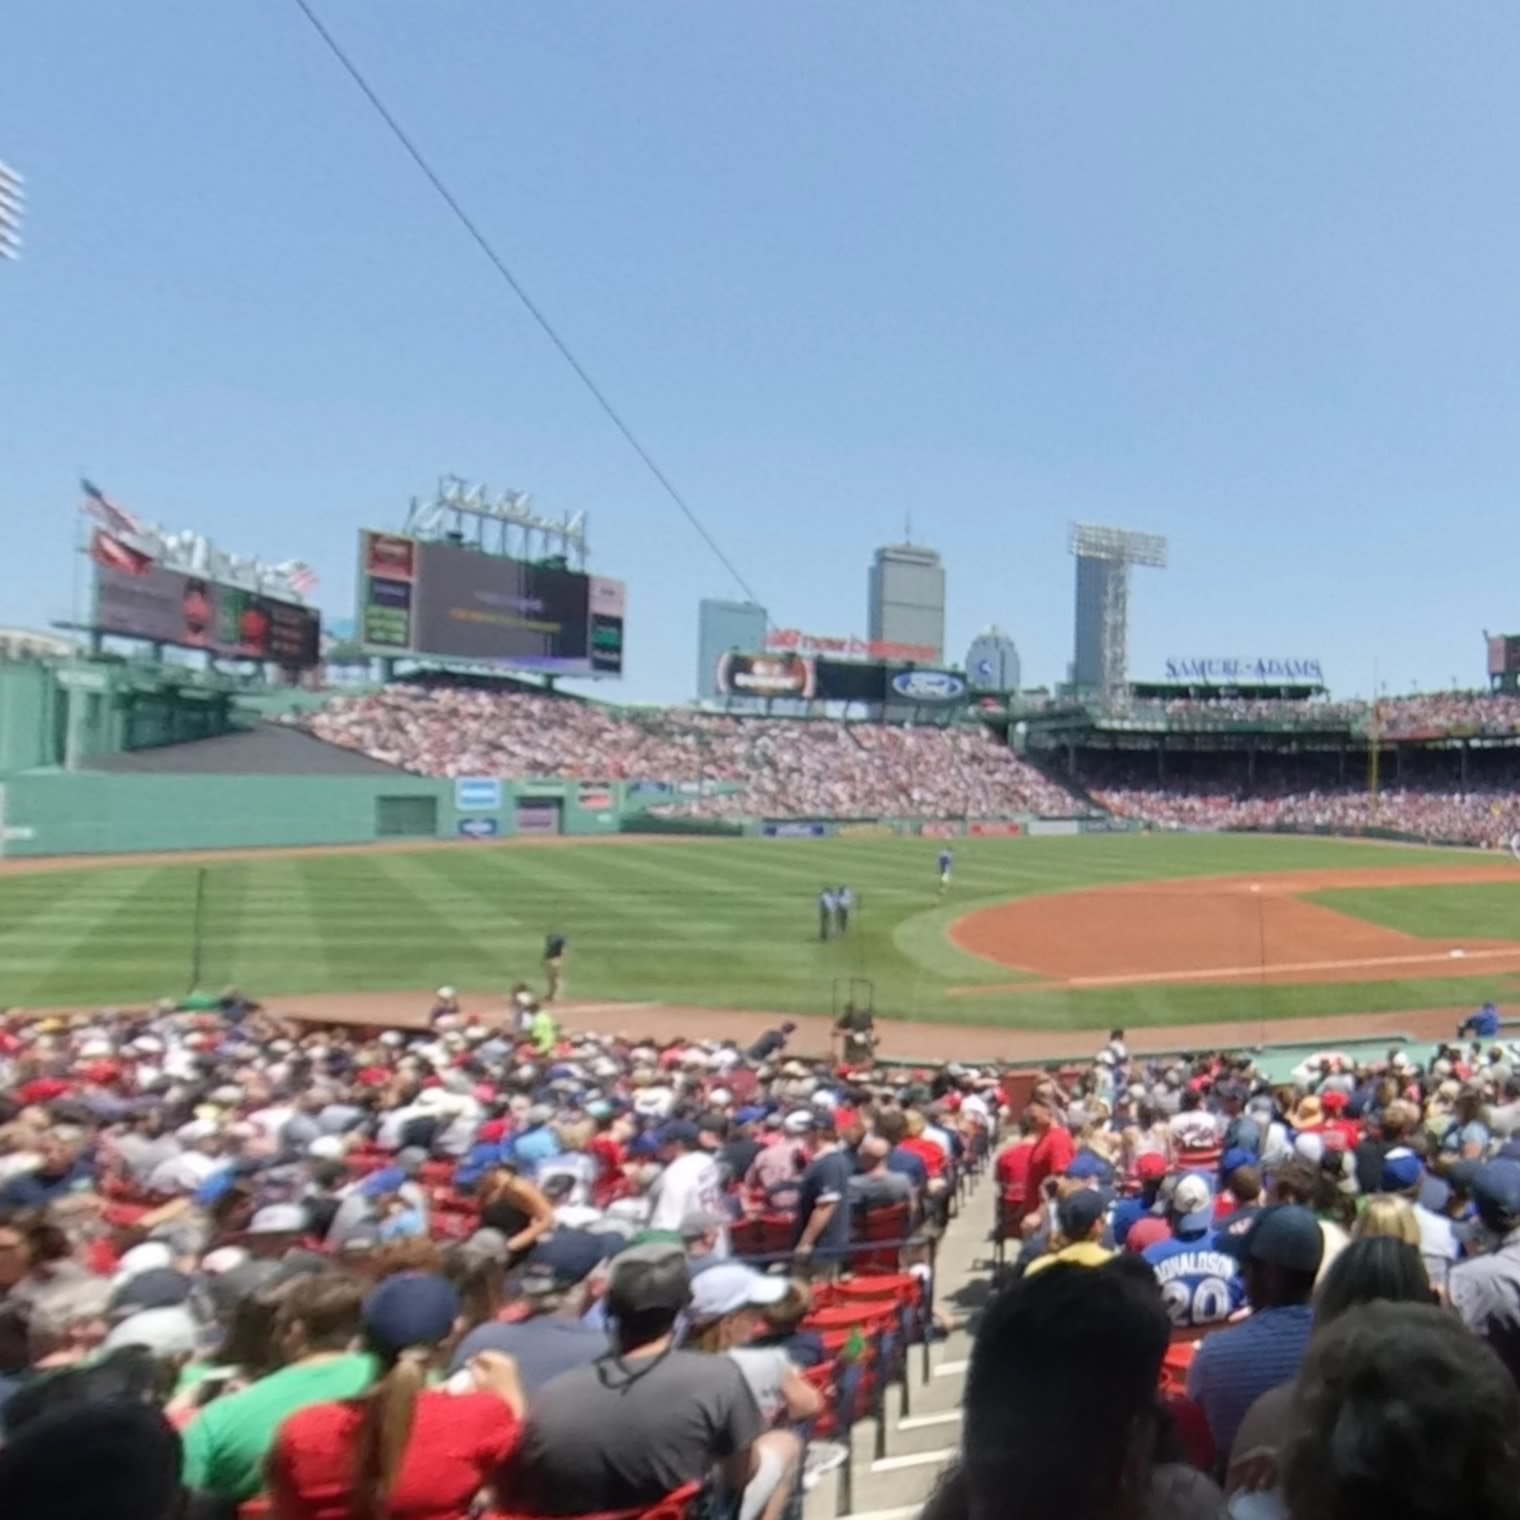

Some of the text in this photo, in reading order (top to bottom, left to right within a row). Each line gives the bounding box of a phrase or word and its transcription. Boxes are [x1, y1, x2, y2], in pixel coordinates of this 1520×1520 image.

[1165, 656, 1322, 678] SAMUEL ADAMS
[1161, 1277, 1229, 1326] 20
